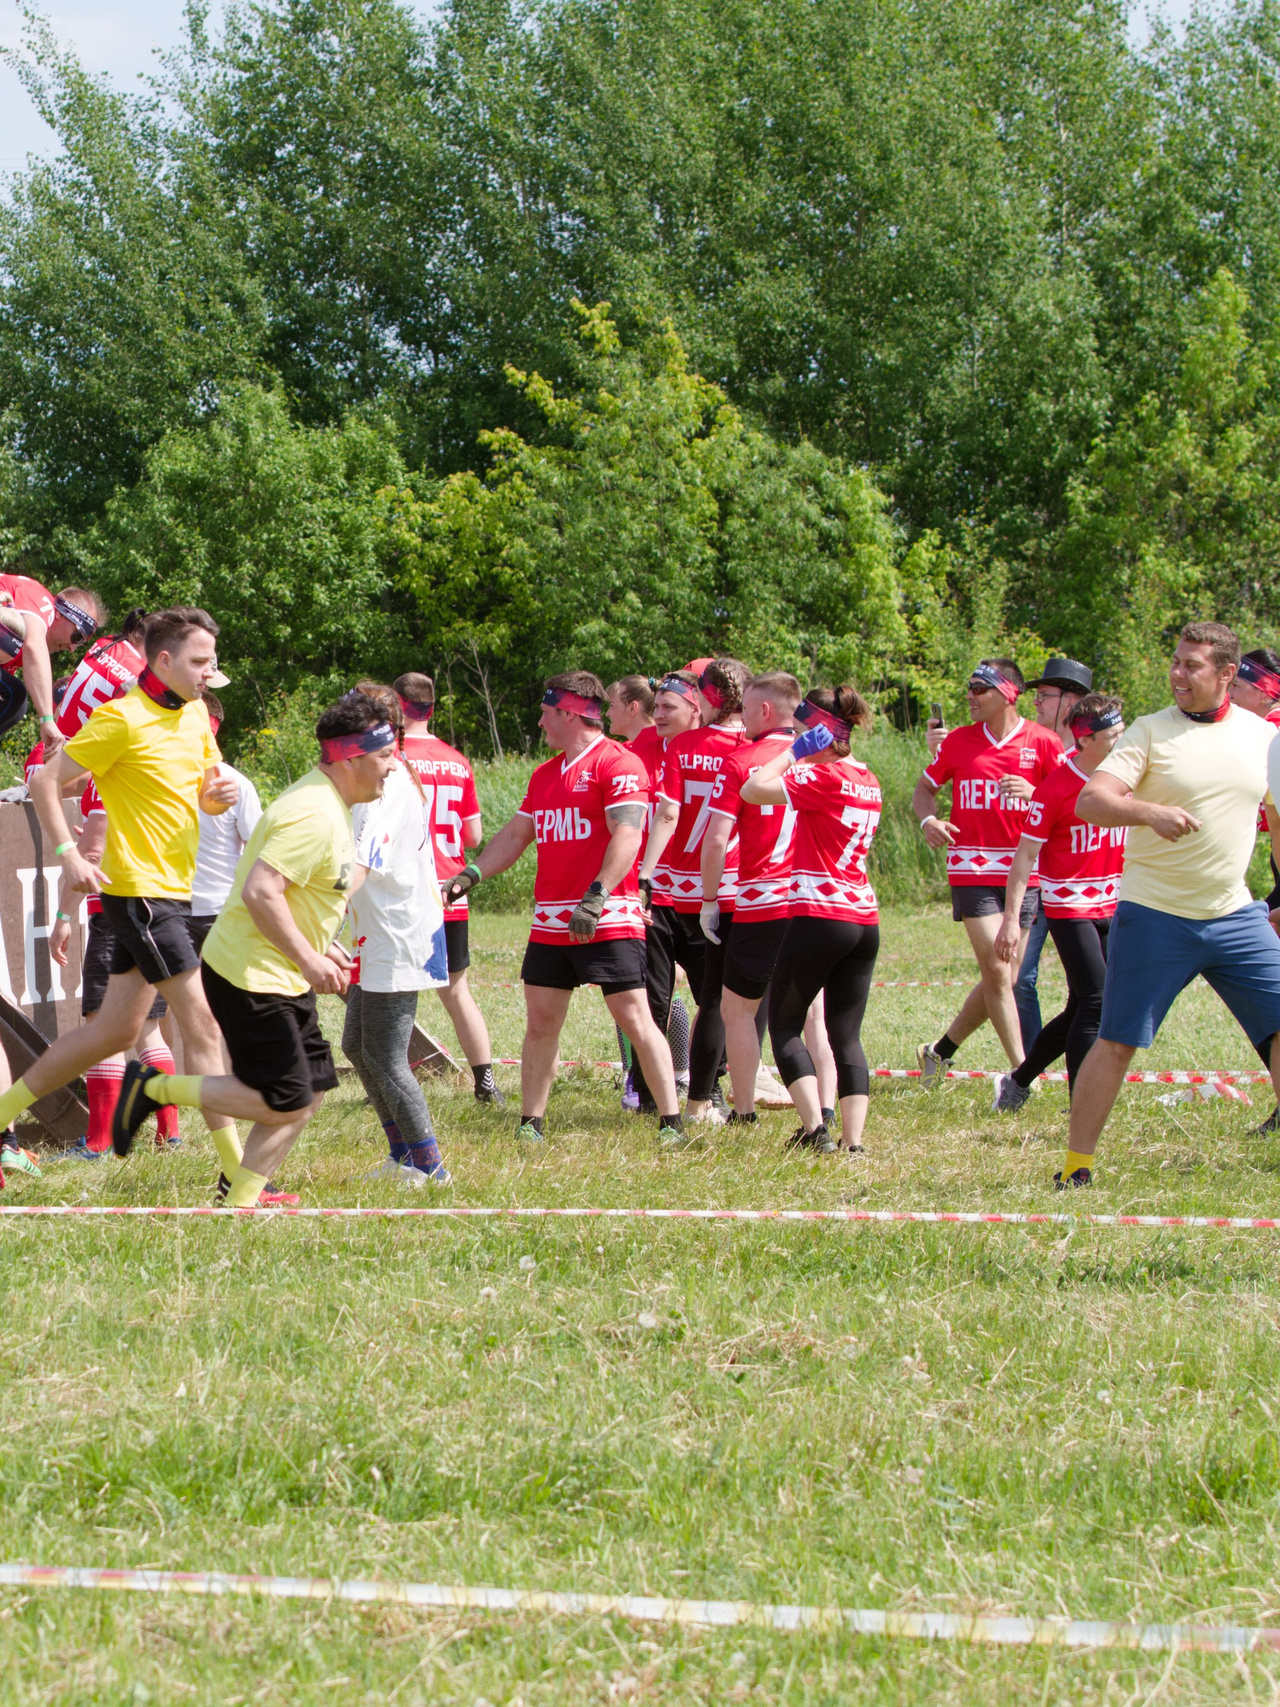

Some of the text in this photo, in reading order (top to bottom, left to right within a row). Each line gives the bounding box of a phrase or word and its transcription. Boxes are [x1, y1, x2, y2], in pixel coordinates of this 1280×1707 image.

[612, 774, 640, 797] 75
[532, 807, 593, 845] ЕРМЬ
[1070, 823, 1130, 855] ПЕРМ
